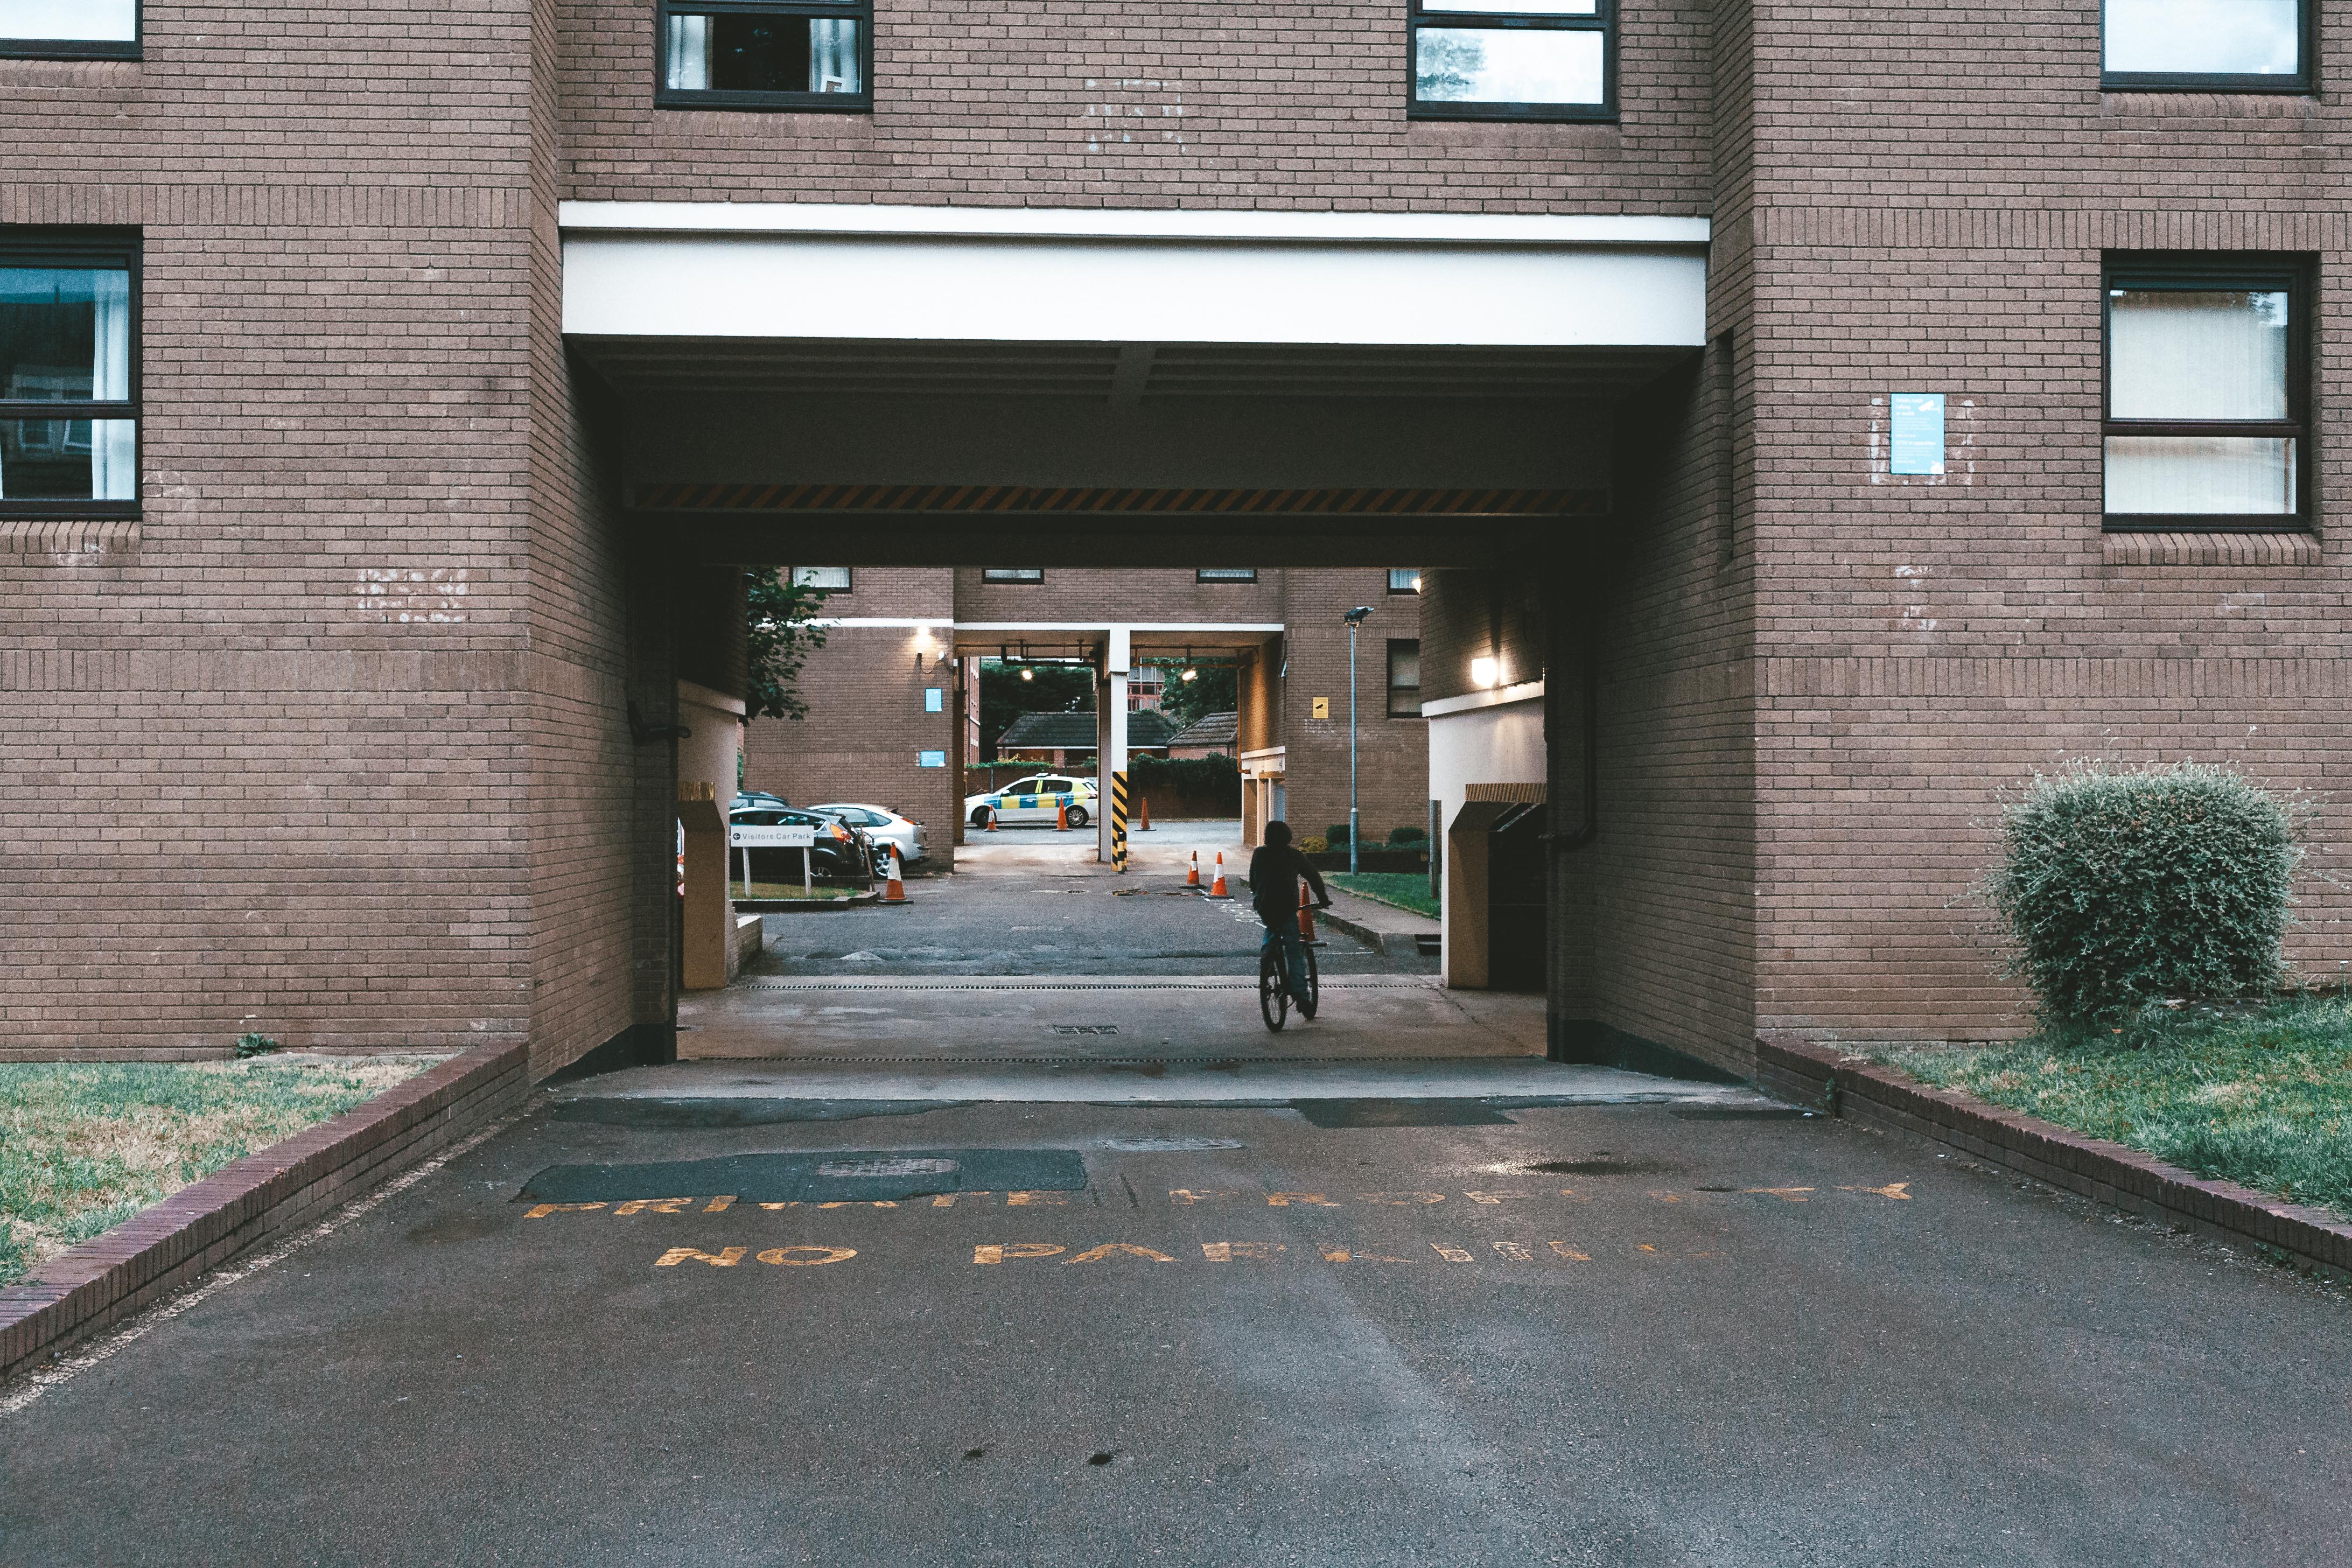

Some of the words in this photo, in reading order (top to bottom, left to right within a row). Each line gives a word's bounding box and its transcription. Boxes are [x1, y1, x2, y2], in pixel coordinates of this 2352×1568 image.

[1168, 1182, 1913, 1206] PROPTY
[654, 1245, 858, 1266] NO
[974, 1241, 1727, 1264] PARKIN
